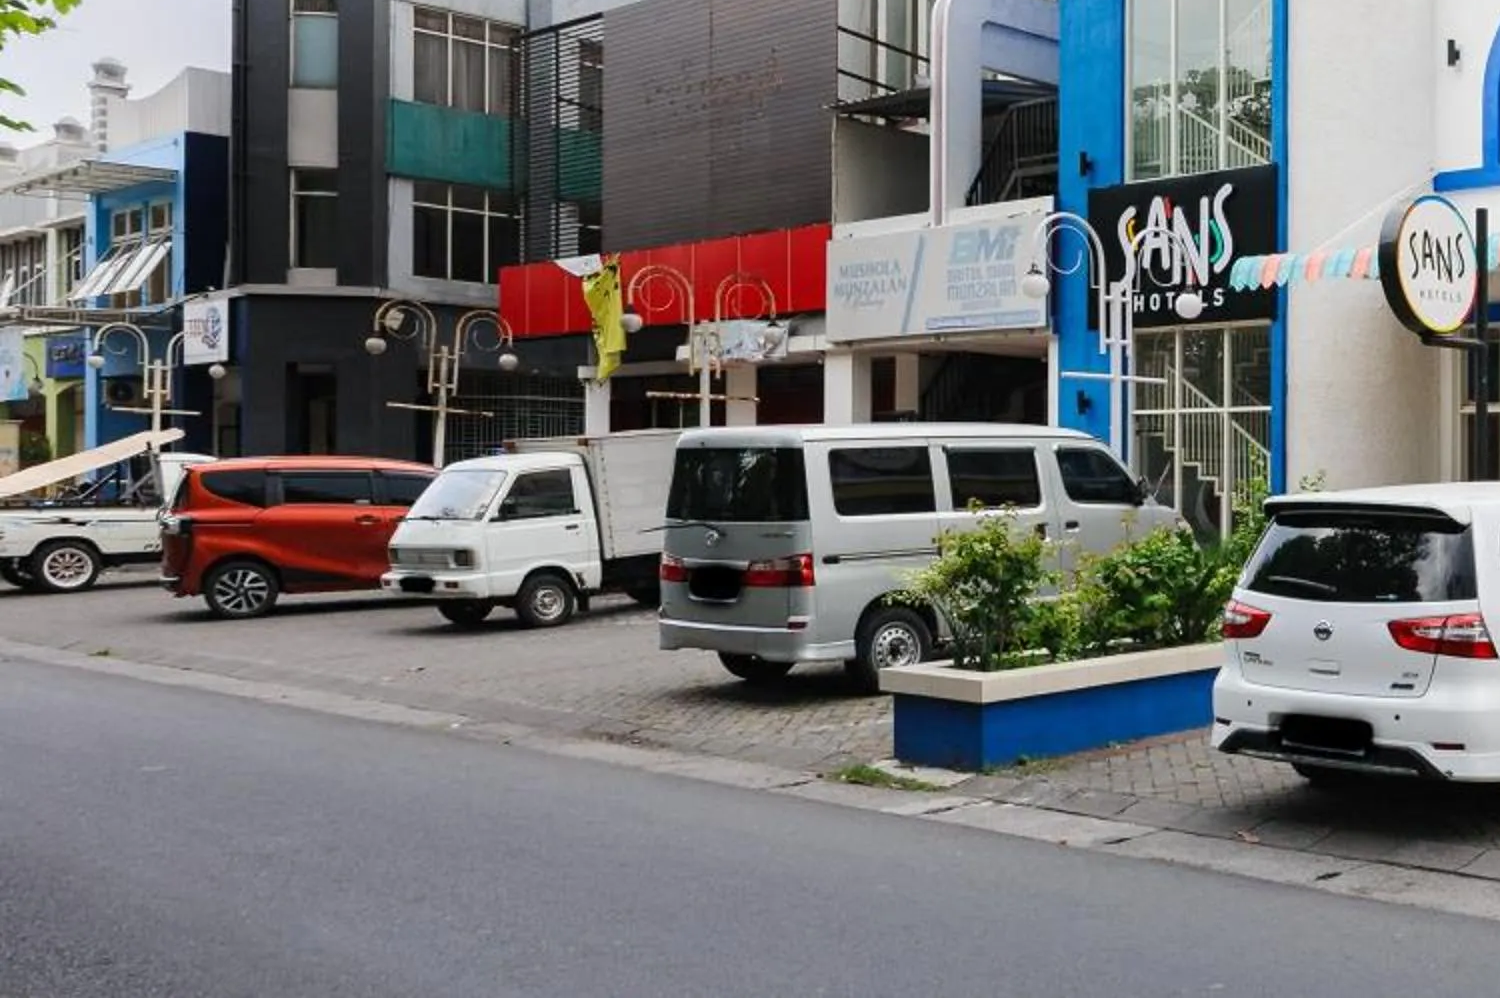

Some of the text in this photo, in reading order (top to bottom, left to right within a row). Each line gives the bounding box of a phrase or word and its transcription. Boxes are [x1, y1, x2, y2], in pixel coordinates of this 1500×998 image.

[1116, 183, 1234, 290] SANS
[1409, 229, 1465, 283] SANS
[839, 259, 901, 279] MUSHOLA
[834, 276, 907, 299] MUNZALAN
[1419, 289, 1462, 303] HOTELS
[1133, 287, 1225, 314] HOTLS
